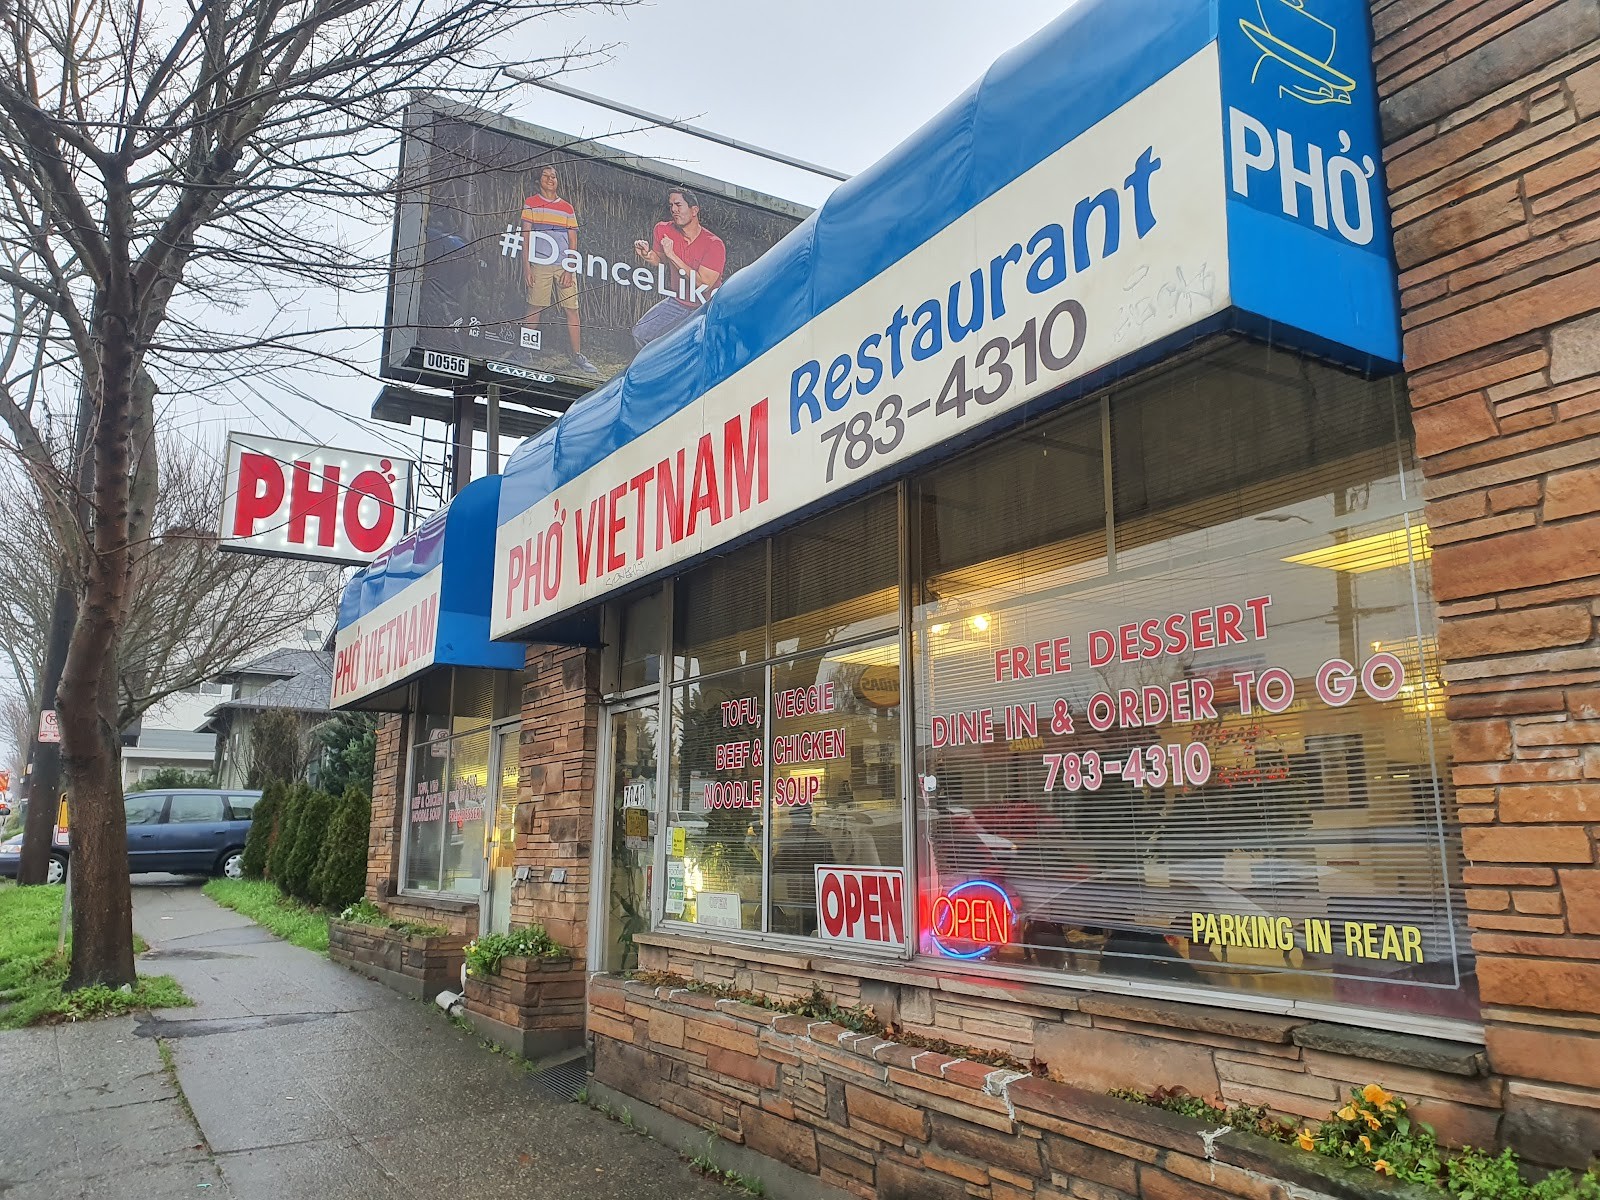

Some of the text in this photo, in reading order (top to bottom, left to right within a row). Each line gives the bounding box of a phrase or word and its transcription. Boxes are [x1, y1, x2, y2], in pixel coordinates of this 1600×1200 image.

[1229, 106, 1375, 245] PHỞ
[790, 146, 1161, 434] Restaurant
[428, 353, 465, 373] 00556
[523, 332, 539, 343] ad
[492, 364, 548, 382] LAMAR
[820, 299, 1087, 483] 783-4310
[233, 452, 396, 553] PHỞ
[506, 397, 769, 619] PHỞ VIETNAM
[334, 592, 437, 698] PHỞ VIETNAM
[994, 595, 1272, 683] FREE DESSERT
[721, 681, 834, 728] TOFU, VEGGIE
[931, 707, 994, 749] DINE
[1004, 702, 1038, 740] IN
[1050, 698, 1076, 735] &
[1087, 678, 1216, 731] ORDER
[1233, 667, 1295, 714] TO
[1315, 651, 1405, 707] GO
[716, 740, 750, 770] BEEF
[752, 739, 762, 767] &
[773, 728, 845, 765] CHICKEN
[1042, 741, 1211, 791] 783-4310
[704, 780, 761, 809] NOODLE
[775, 775, 819, 806] SOUP
[822, 873, 904, 944] OPEN
[932, 896, 1007, 944] OPEN
[1191, 912, 1424, 964] PARKING IN REAR
